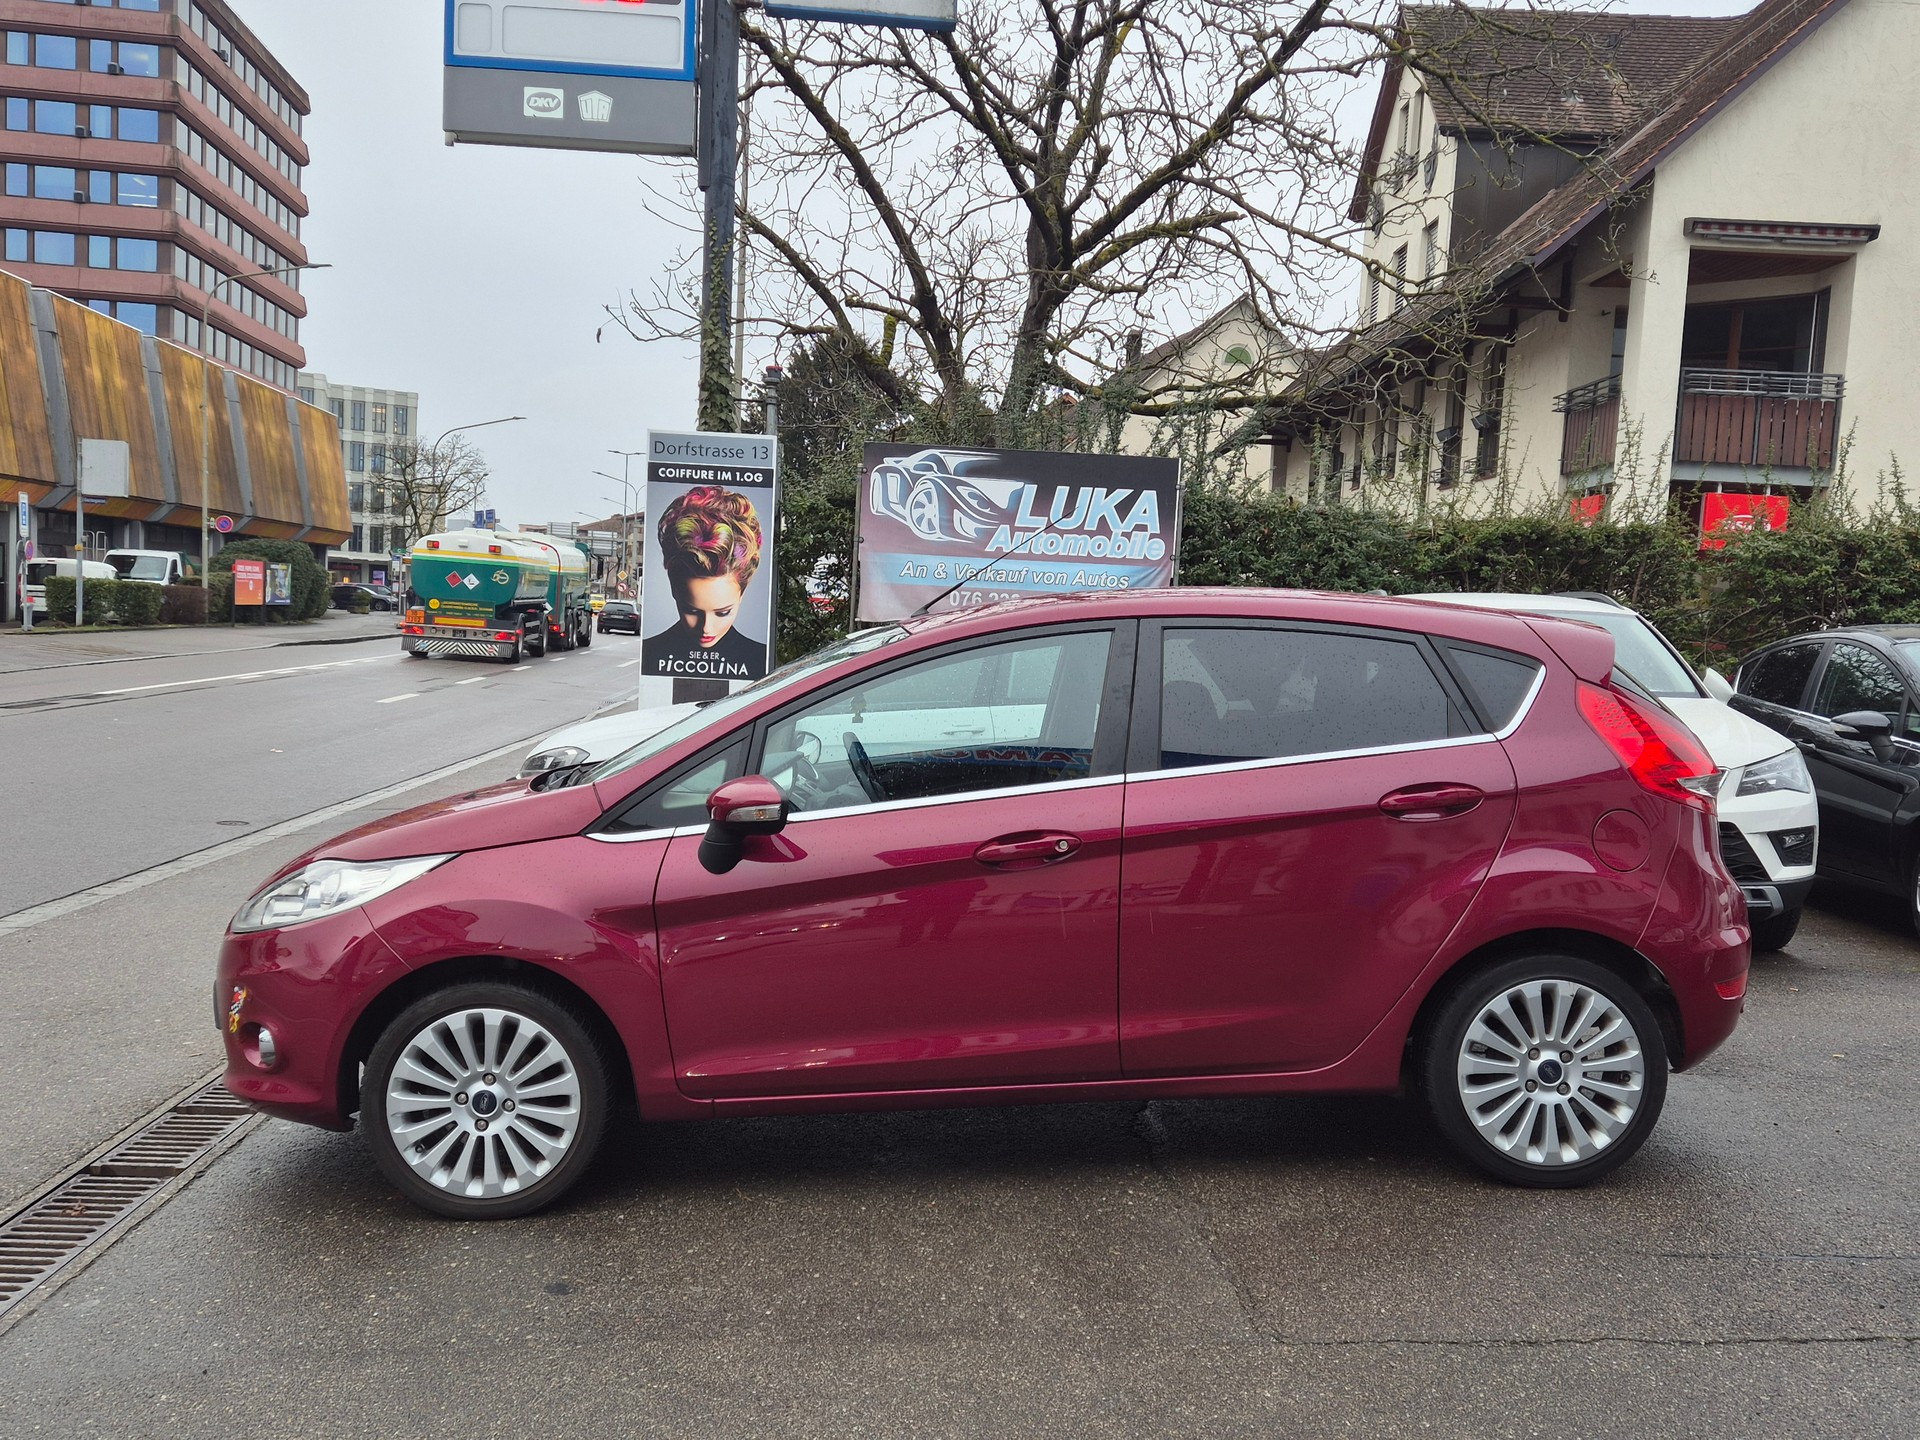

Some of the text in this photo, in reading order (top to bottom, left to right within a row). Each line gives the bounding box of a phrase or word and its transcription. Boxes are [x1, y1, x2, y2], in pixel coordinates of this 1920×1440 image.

[528, 96, 559, 108] DKV
[580, 91, 612, 120] UTA
[653, 440, 769, 460] Dorfstrasse 13
[657, 467, 764, 483] COIFFURE IM 1.OG
[1014, 483, 1161, 534] LUKA
[984, 524, 1166, 561] Automobile
[899, 561, 1131, 589] An & Verkauf von Autos
[949, 590, 982, 607] 076
[688, 650, 720, 660] SIE & ER
